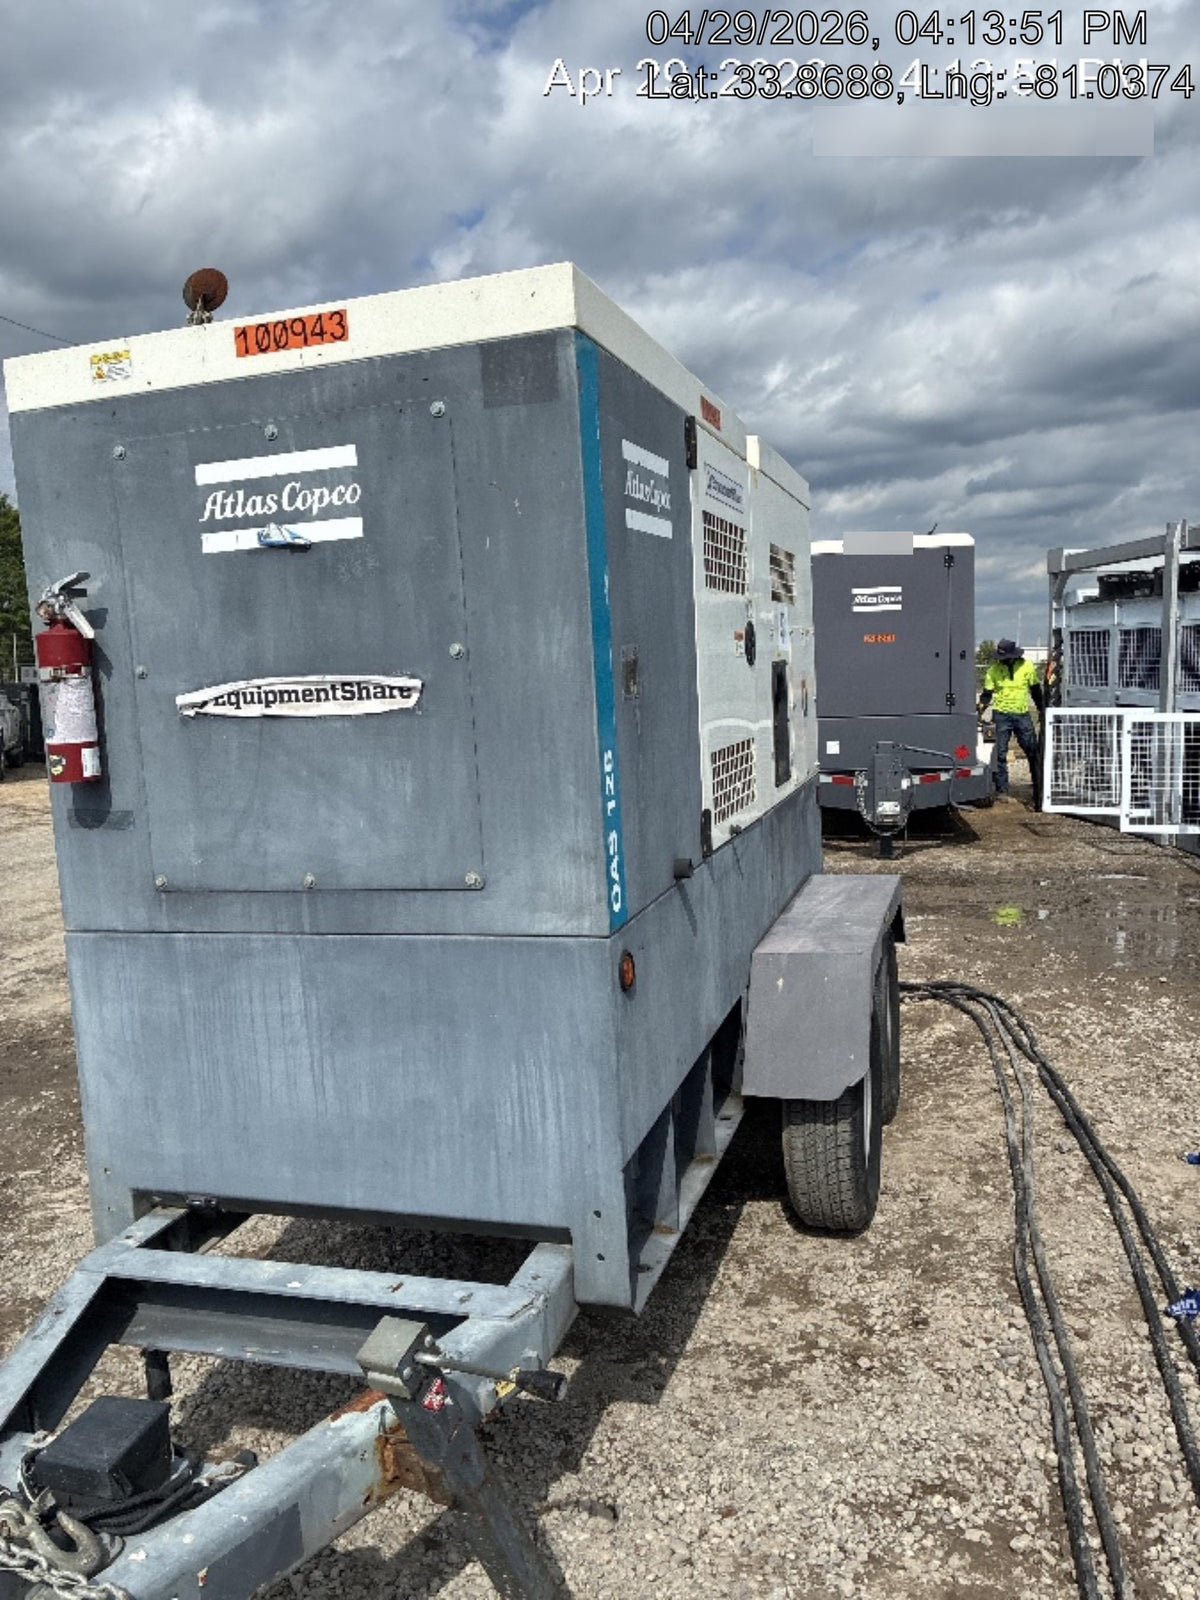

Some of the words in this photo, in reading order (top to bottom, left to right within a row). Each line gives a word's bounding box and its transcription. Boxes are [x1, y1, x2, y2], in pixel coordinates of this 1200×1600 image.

[236, 311, 346, 355] 100943
[198, 488, 279, 522] Atlas
[281, 481, 362, 516] Copco
[623, 470, 651, 502] Atlas
